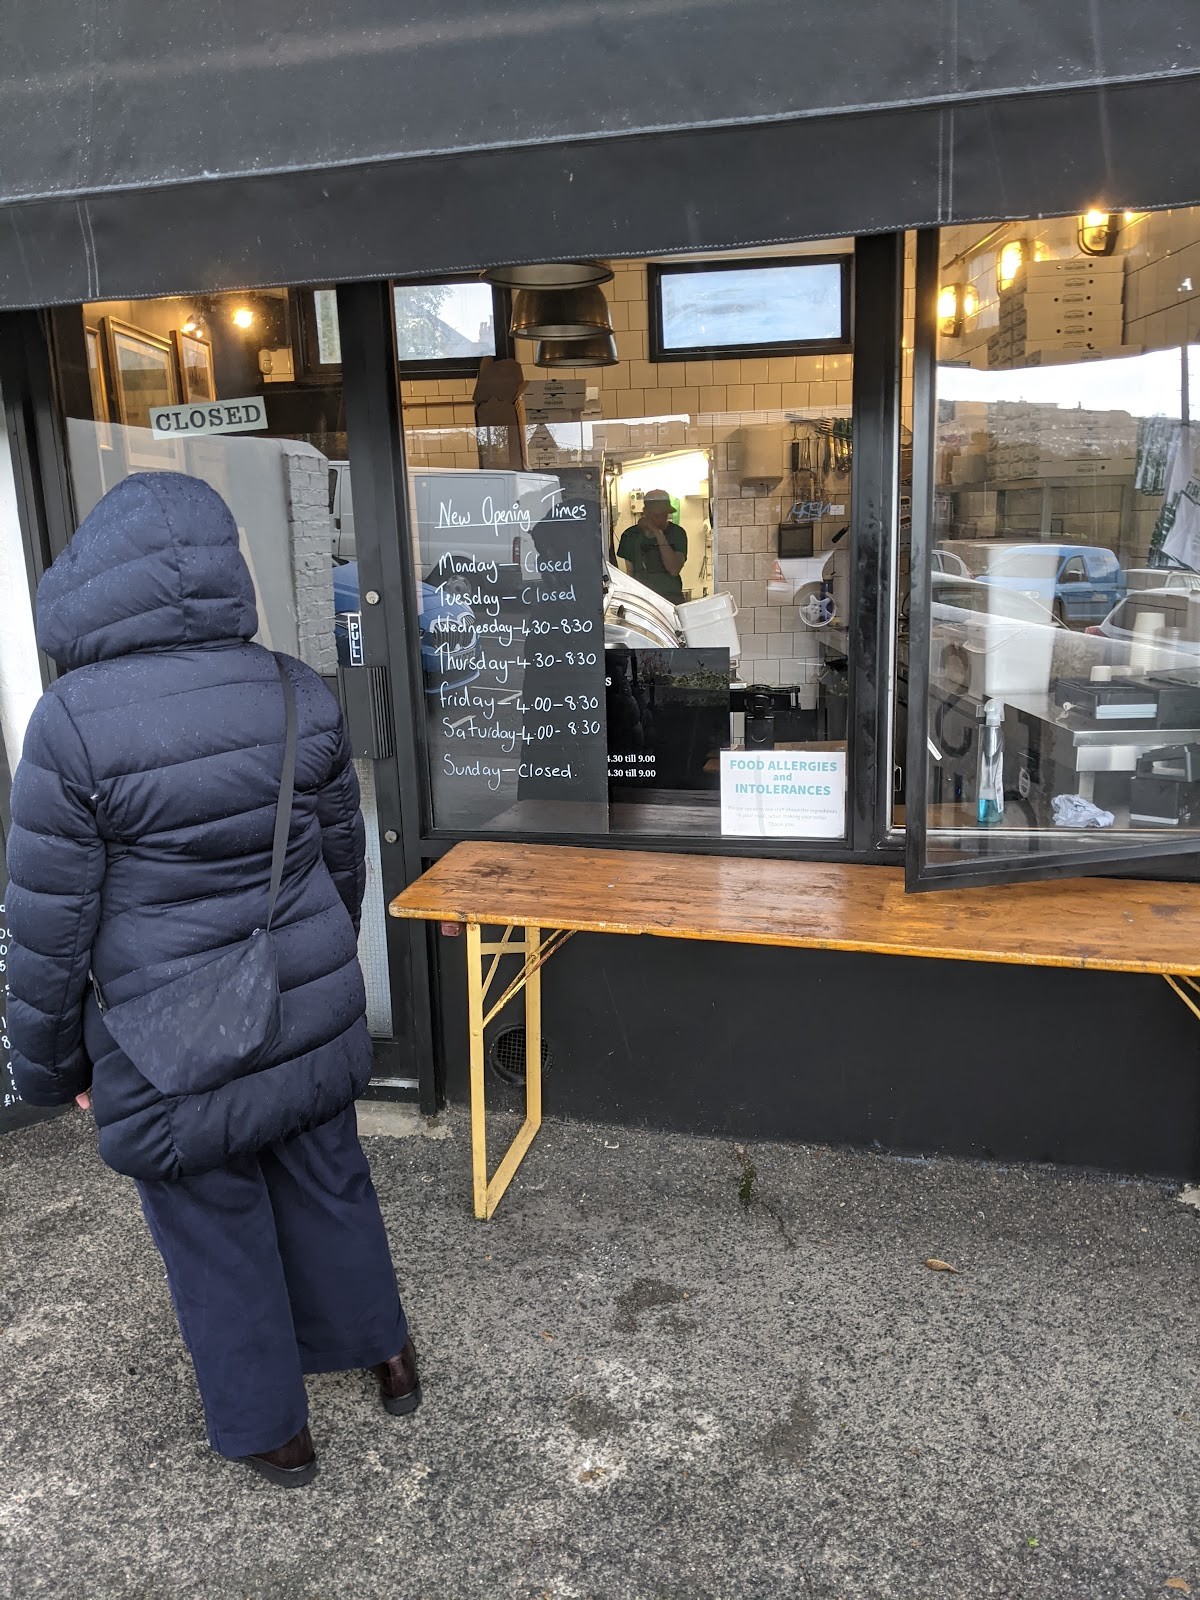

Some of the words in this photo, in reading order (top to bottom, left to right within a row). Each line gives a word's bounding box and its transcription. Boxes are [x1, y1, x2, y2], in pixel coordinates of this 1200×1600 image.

[155, 404, 261, 432] CLOSED
[439, 499, 471, 527] New
[481, 495, 531, 537] Opening
[541, 487, 587, 520] Times
[524, 551, 573, 573] Closed
[521, 584, 577, 605] Closed
[350, 622, 361, 658] PULL
[624, 754, 637, 763] till
[638, 754, 656, 763] 9.00
[729, 759, 765, 771] FOOD
[767, 760, 838, 772] ALLERGIES
[625, 768, 637, 778] till
[638, 769, 656, 778] 9.00
[773, 772, 793, 782] and
[735, 783, 831, 796] INTOLERANCES
